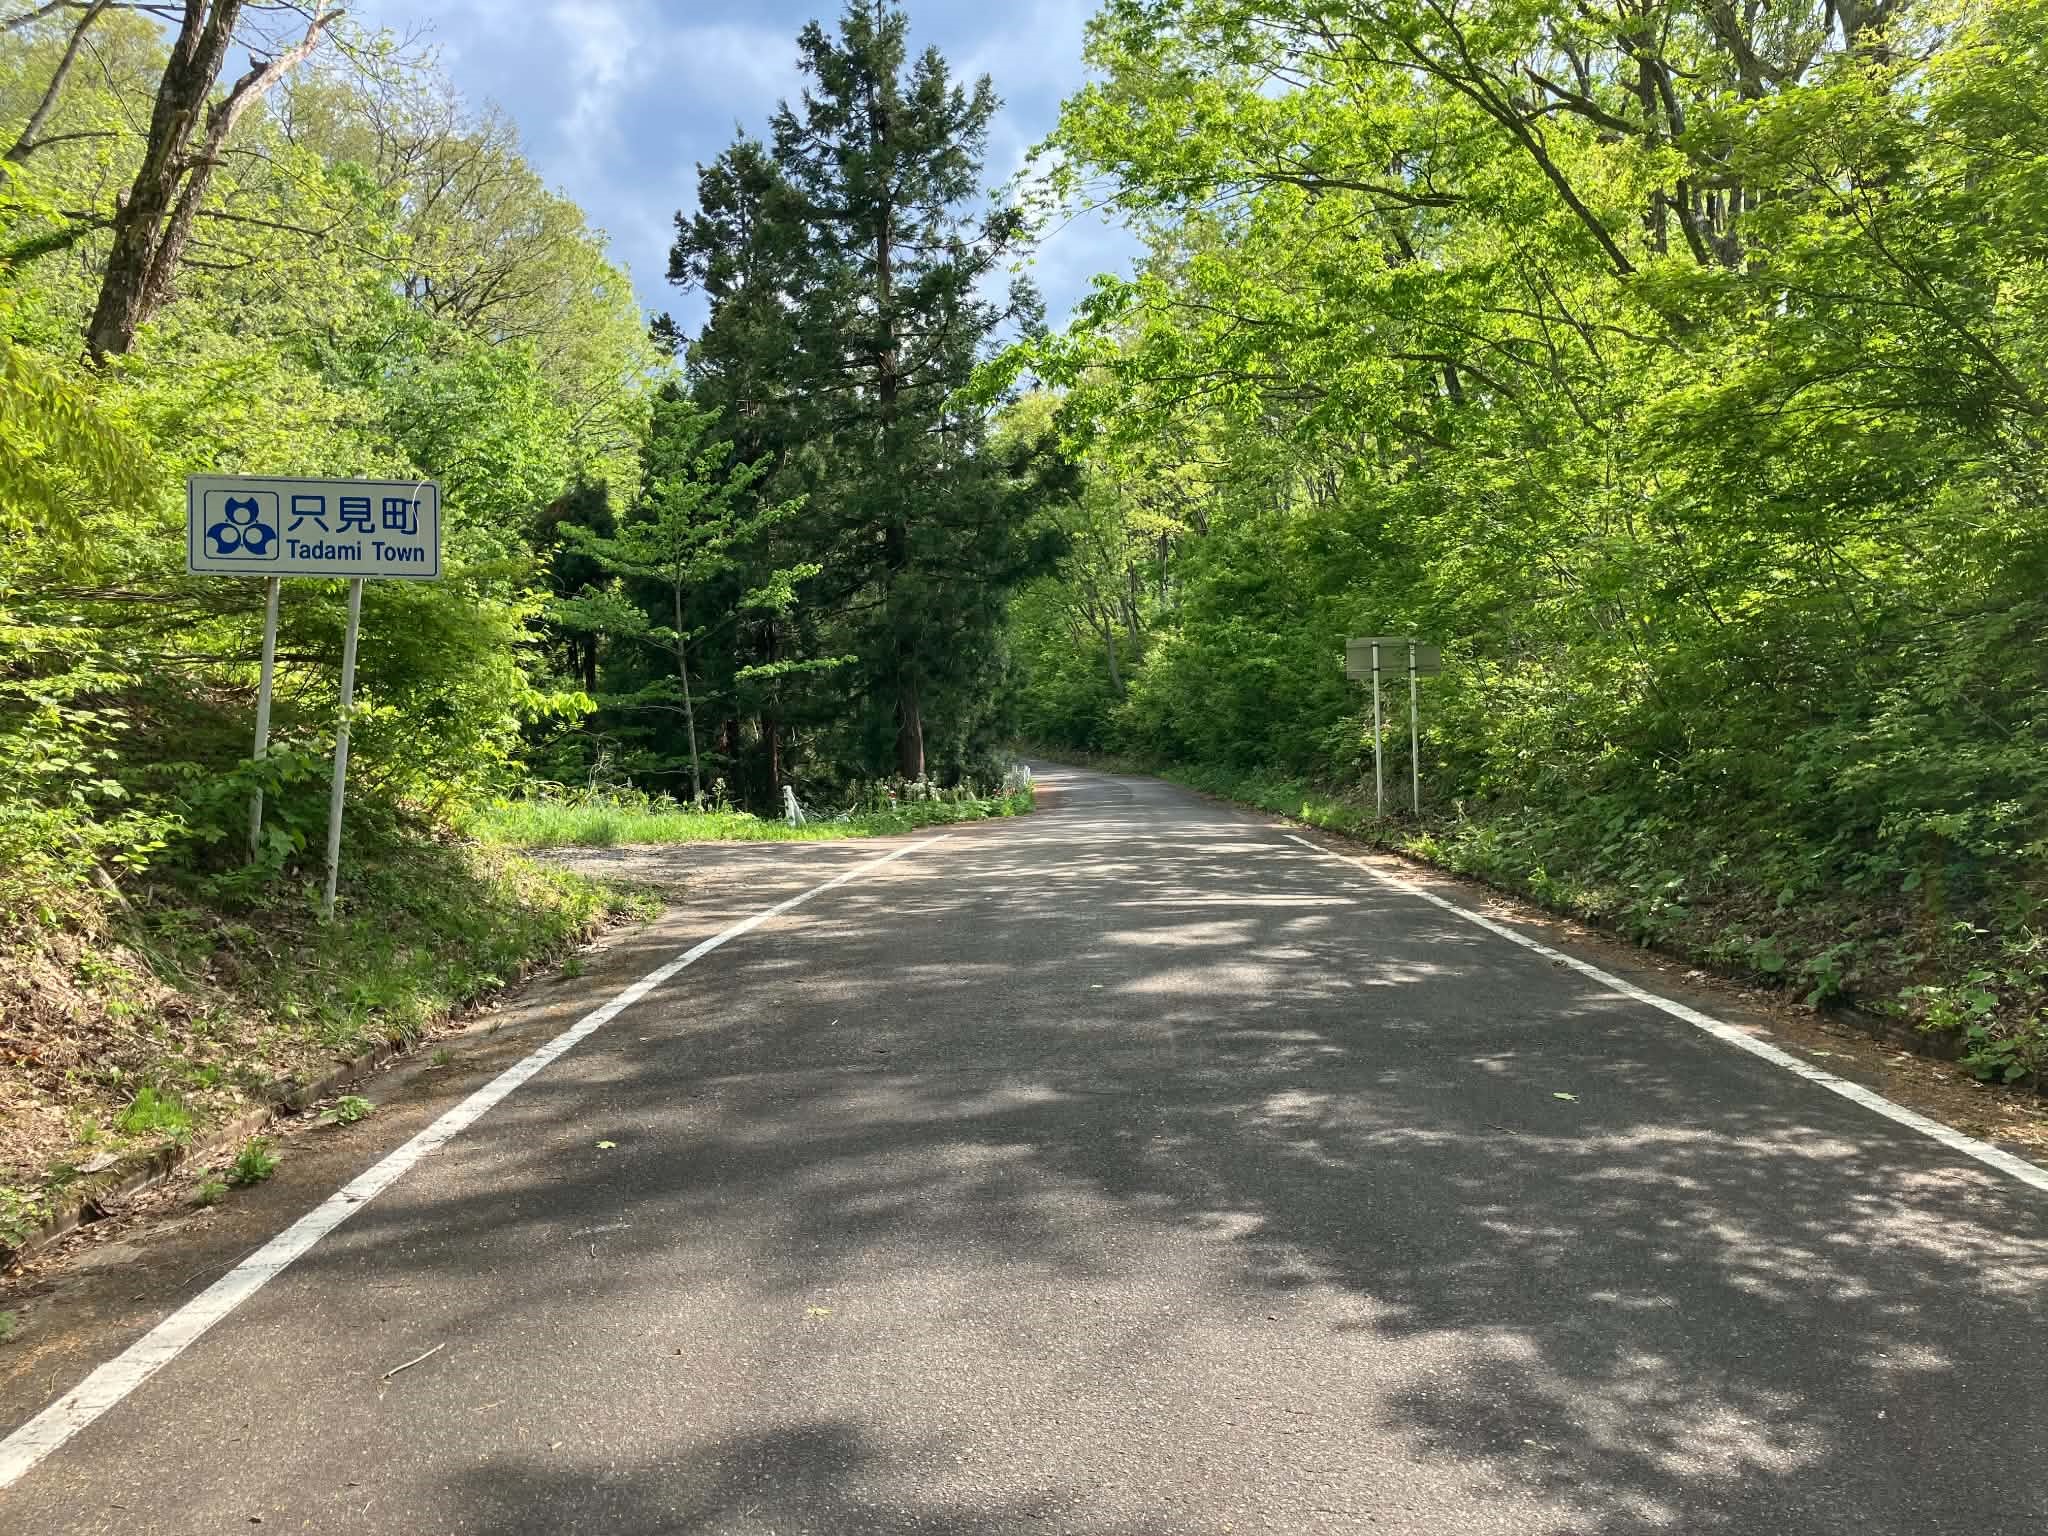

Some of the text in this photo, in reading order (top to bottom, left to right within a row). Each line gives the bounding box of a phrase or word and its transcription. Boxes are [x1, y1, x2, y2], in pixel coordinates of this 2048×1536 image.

[287, 495, 421, 535] 只見町
[286, 539, 425, 562] Tadami Town
